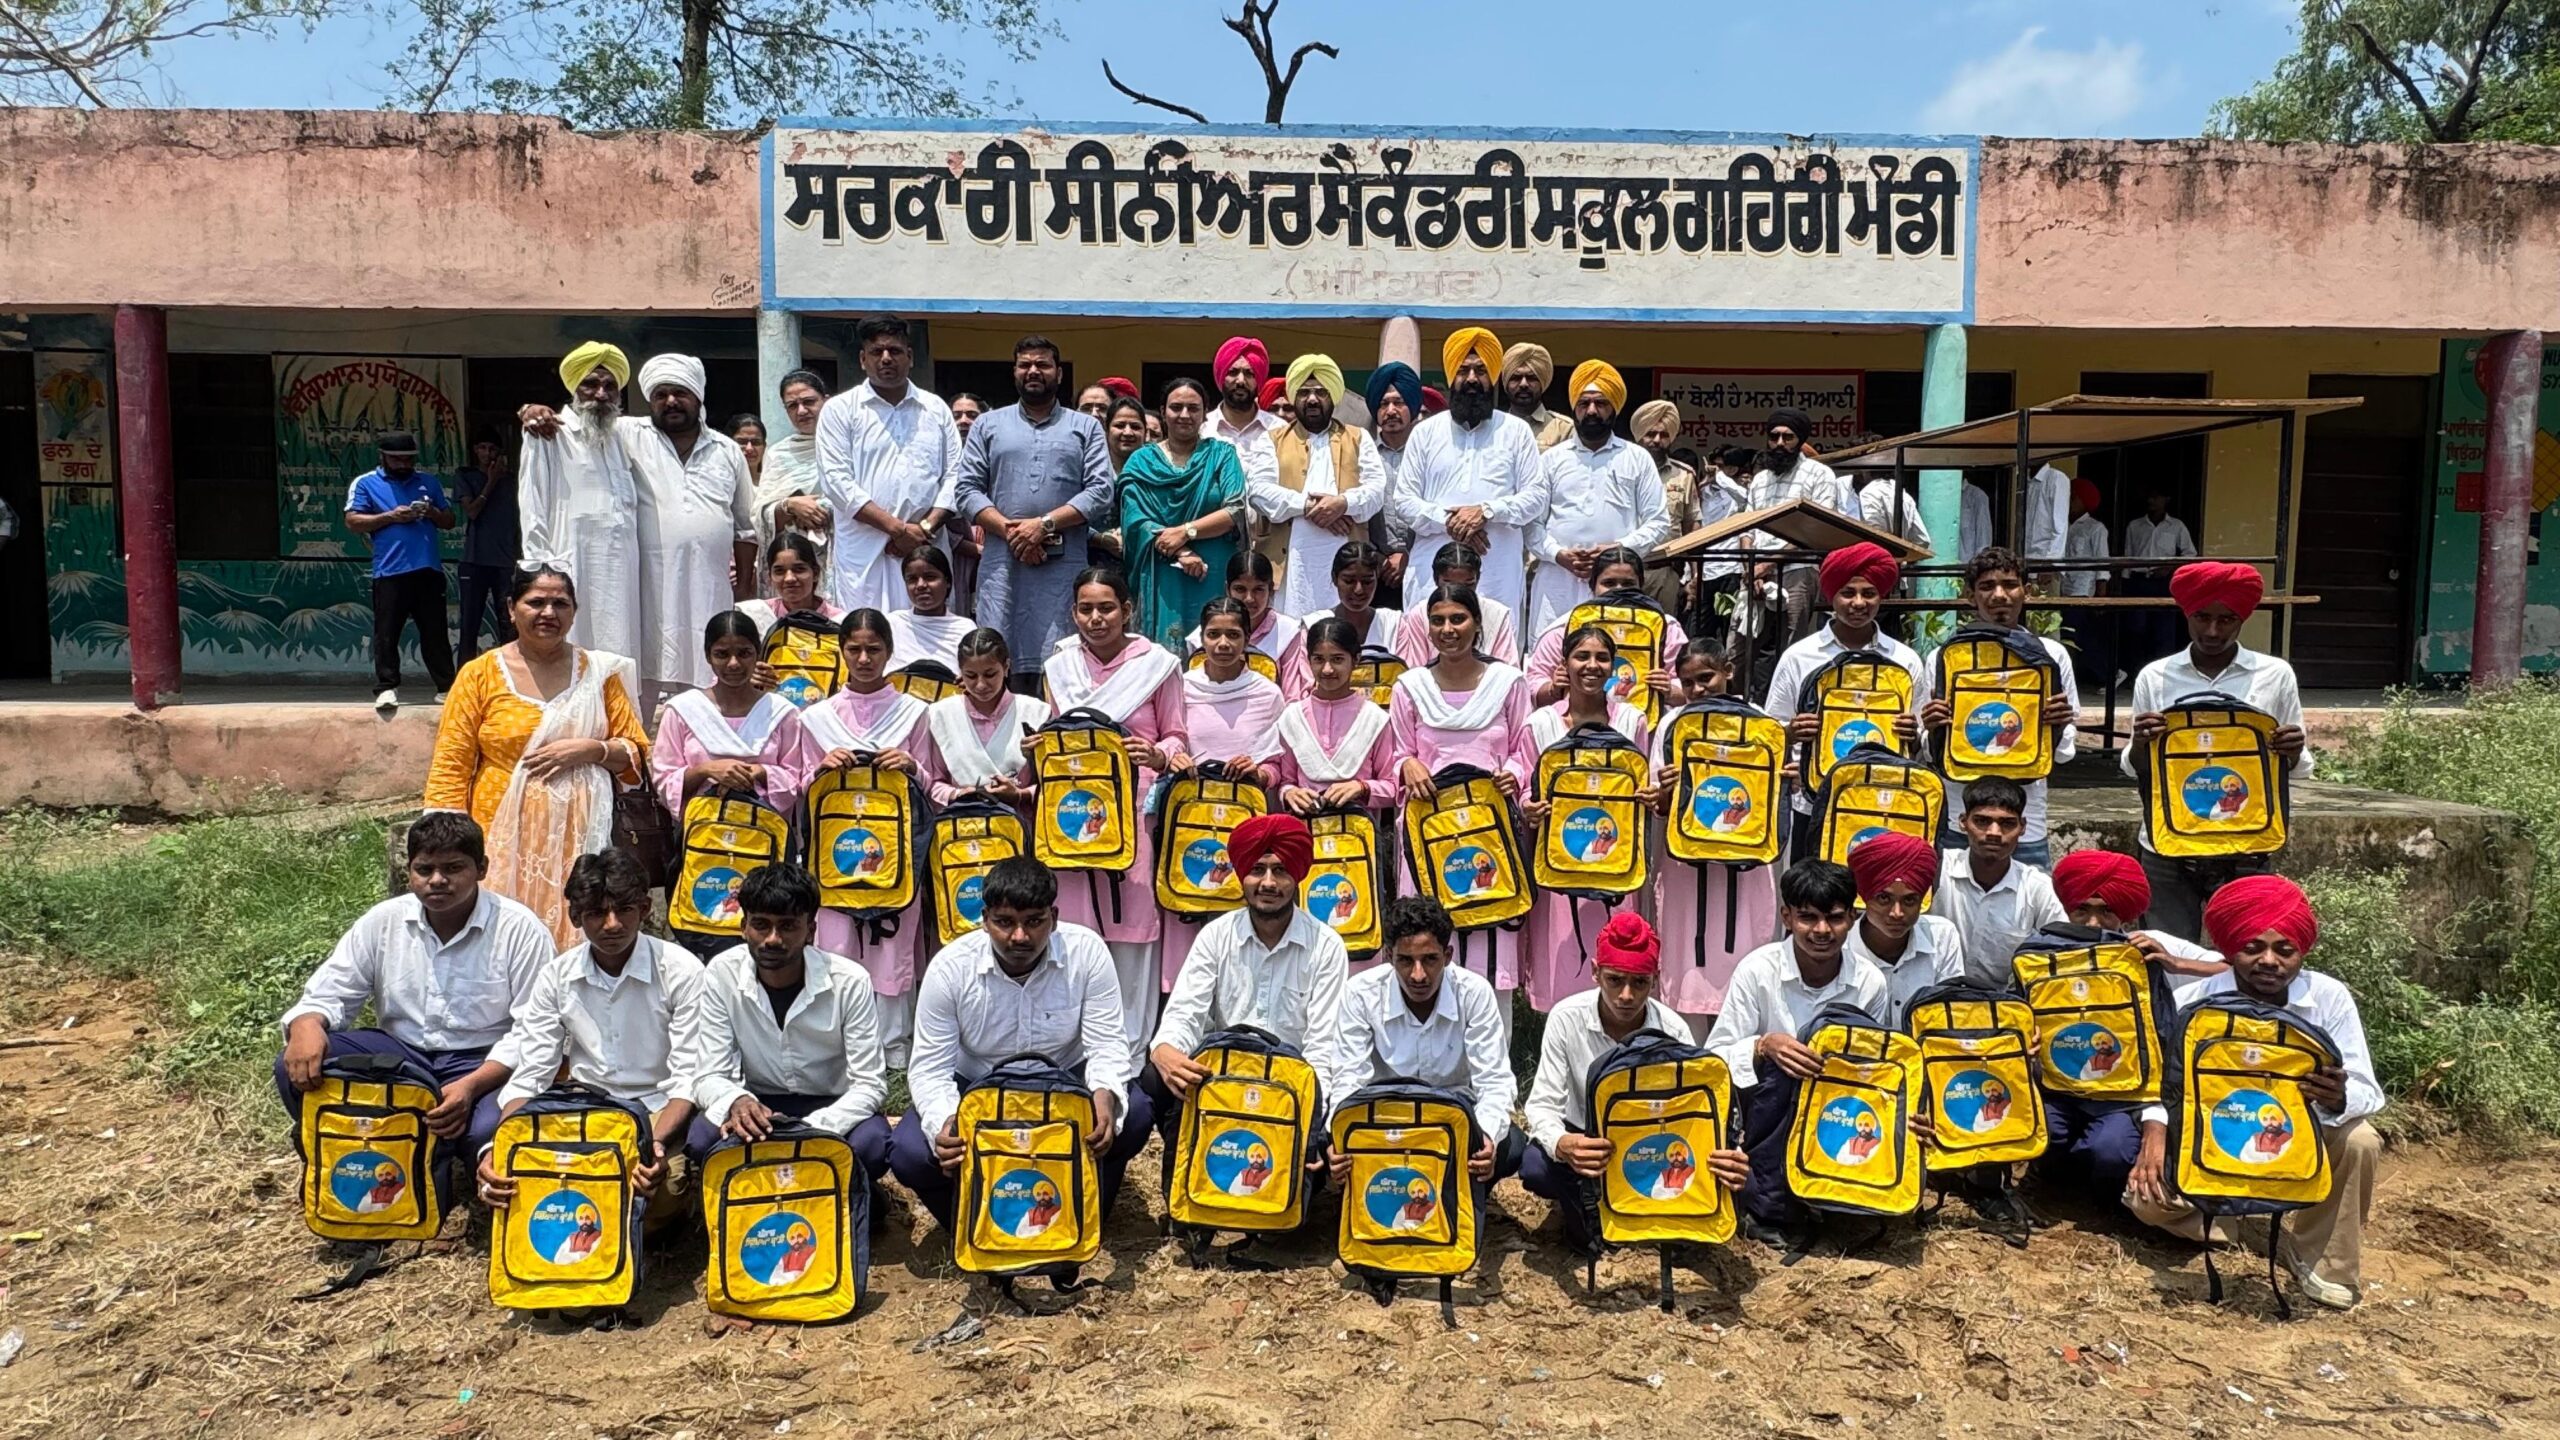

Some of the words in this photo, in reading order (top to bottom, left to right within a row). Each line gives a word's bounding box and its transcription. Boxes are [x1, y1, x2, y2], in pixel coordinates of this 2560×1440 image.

[784, 139, 1041, 243] ਸਰਕਾਰੀ
[1044, 139, 1316, 247] ਸੀਨੀਅਰ
[1317, 142, 1530, 249] ਸੈਕੰਡਰੀ
[1532, 176, 1669, 270] ਸਕੂਲ
[1672, 152, 1844, 254] ਗਹਿਰੀ
[1846, 154, 1961, 257] ਮੰਡੀ
[1727, 382, 1743, 408] ਹੈ
[1745, 390, 1775, 408] ਮਨ
[1776, 384, 1795, 407] ਦੀ
